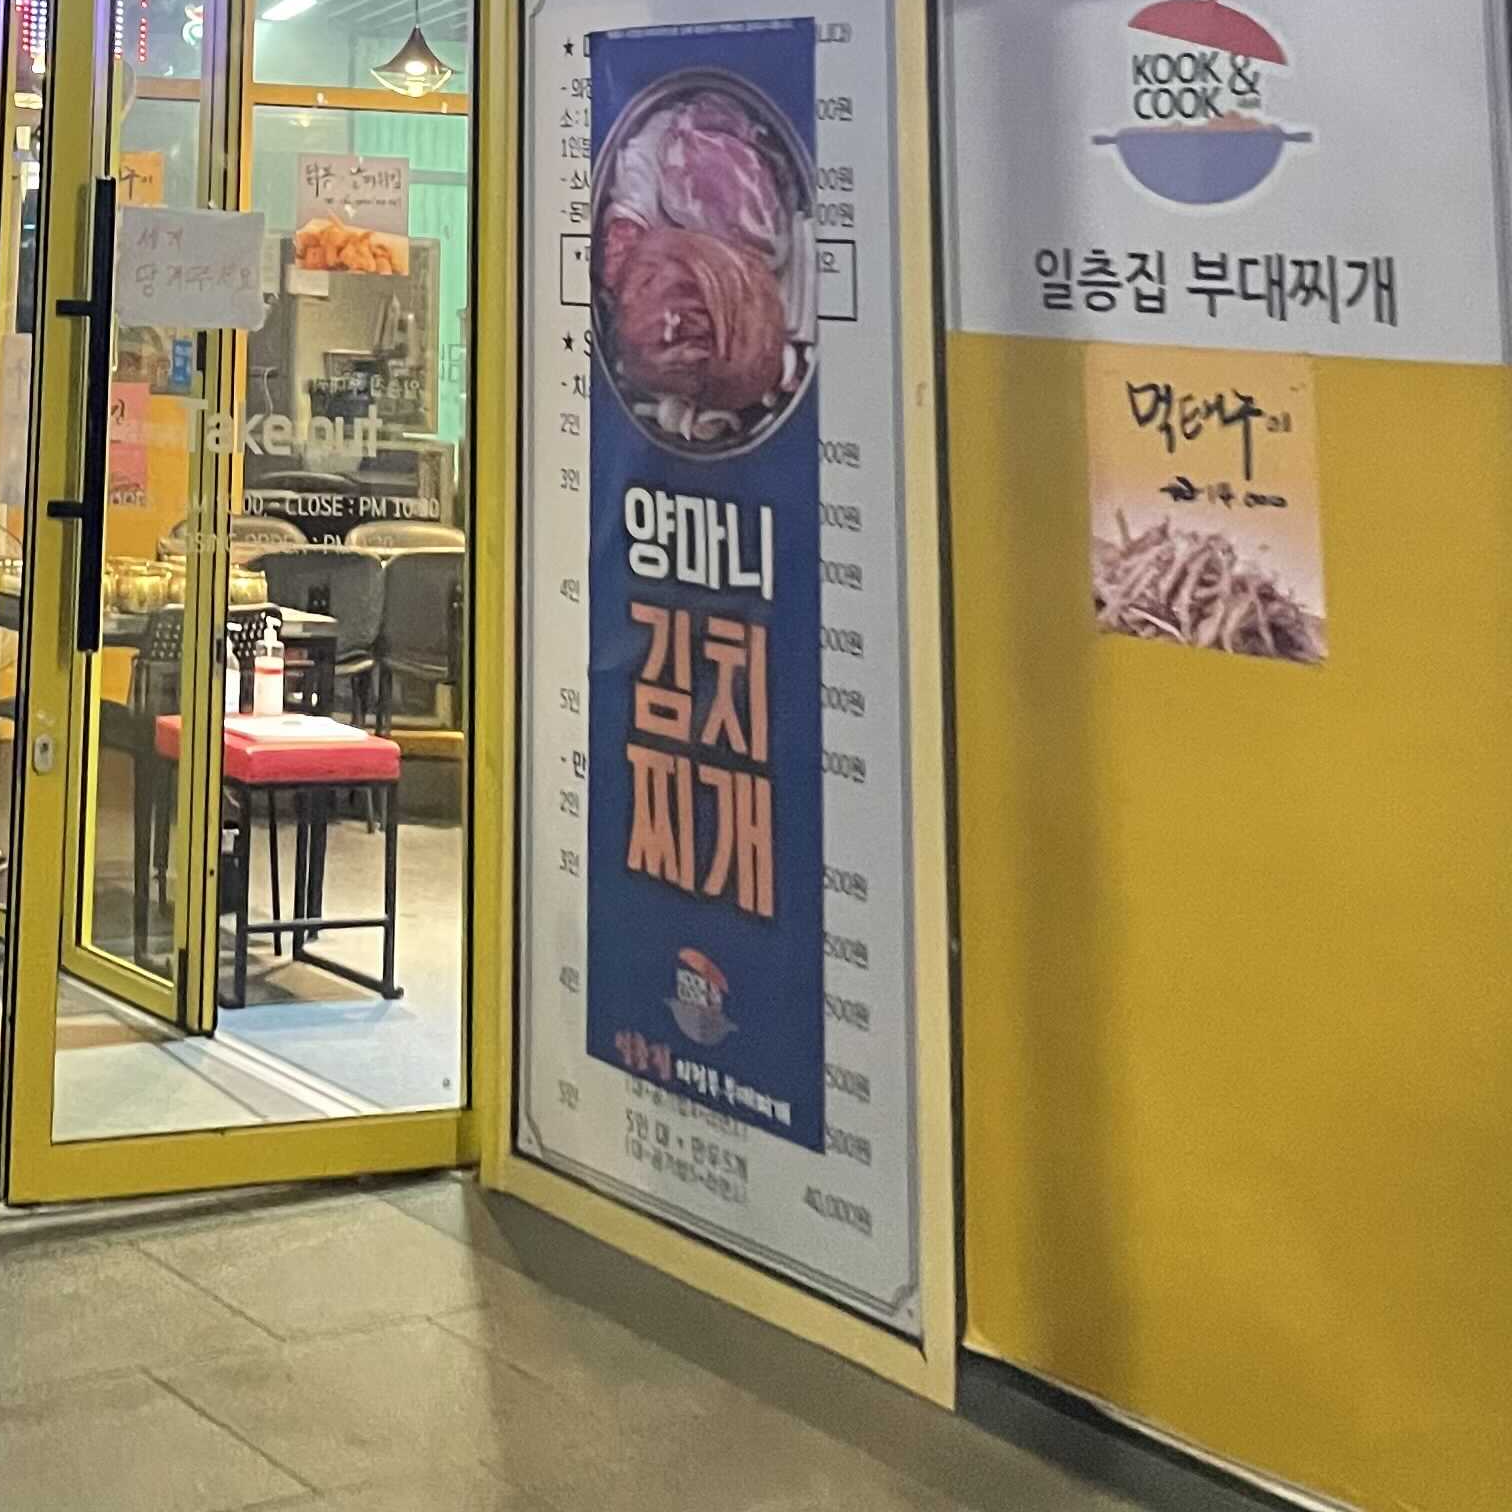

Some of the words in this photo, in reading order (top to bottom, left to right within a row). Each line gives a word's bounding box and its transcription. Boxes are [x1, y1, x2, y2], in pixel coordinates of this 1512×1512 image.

[1131, 51, 1223, 86] KOOK
[1133, 86, 1225, 121] COOK
[1033, 246, 1168, 316] 일층집
[1186, 247, 1399, 328] 부대찌개
[175, 400, 292, 457] Take
[310, 404, 383, 458] out
[359, 497, 387, 519] PM
[625, 485, 775, 601] 양마니
[630, 600, 769, 764] 김치
[625, 743, 775, 919] 찌개
